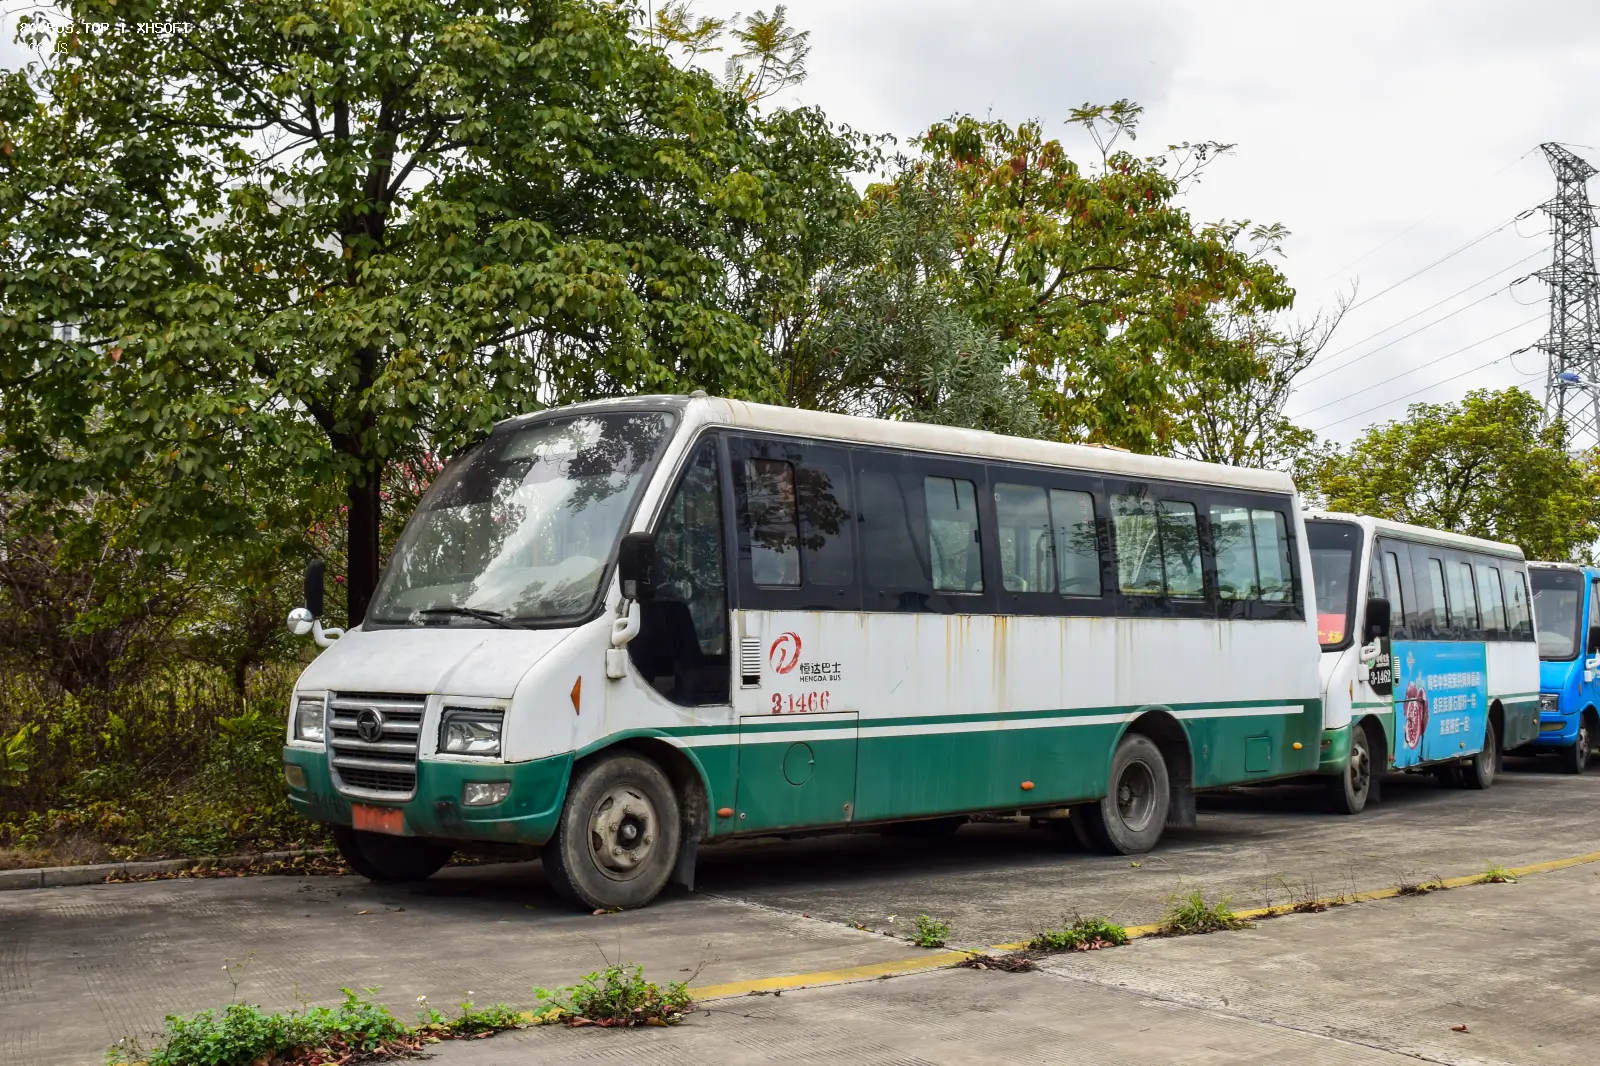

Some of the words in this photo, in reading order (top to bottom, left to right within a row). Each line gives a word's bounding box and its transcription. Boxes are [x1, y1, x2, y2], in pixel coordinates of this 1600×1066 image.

[800, 662, 841, 675] 恒达巴士
[830, 674, 841, 682] BUS
[1370, 669, 1391, 685] 3-1462
